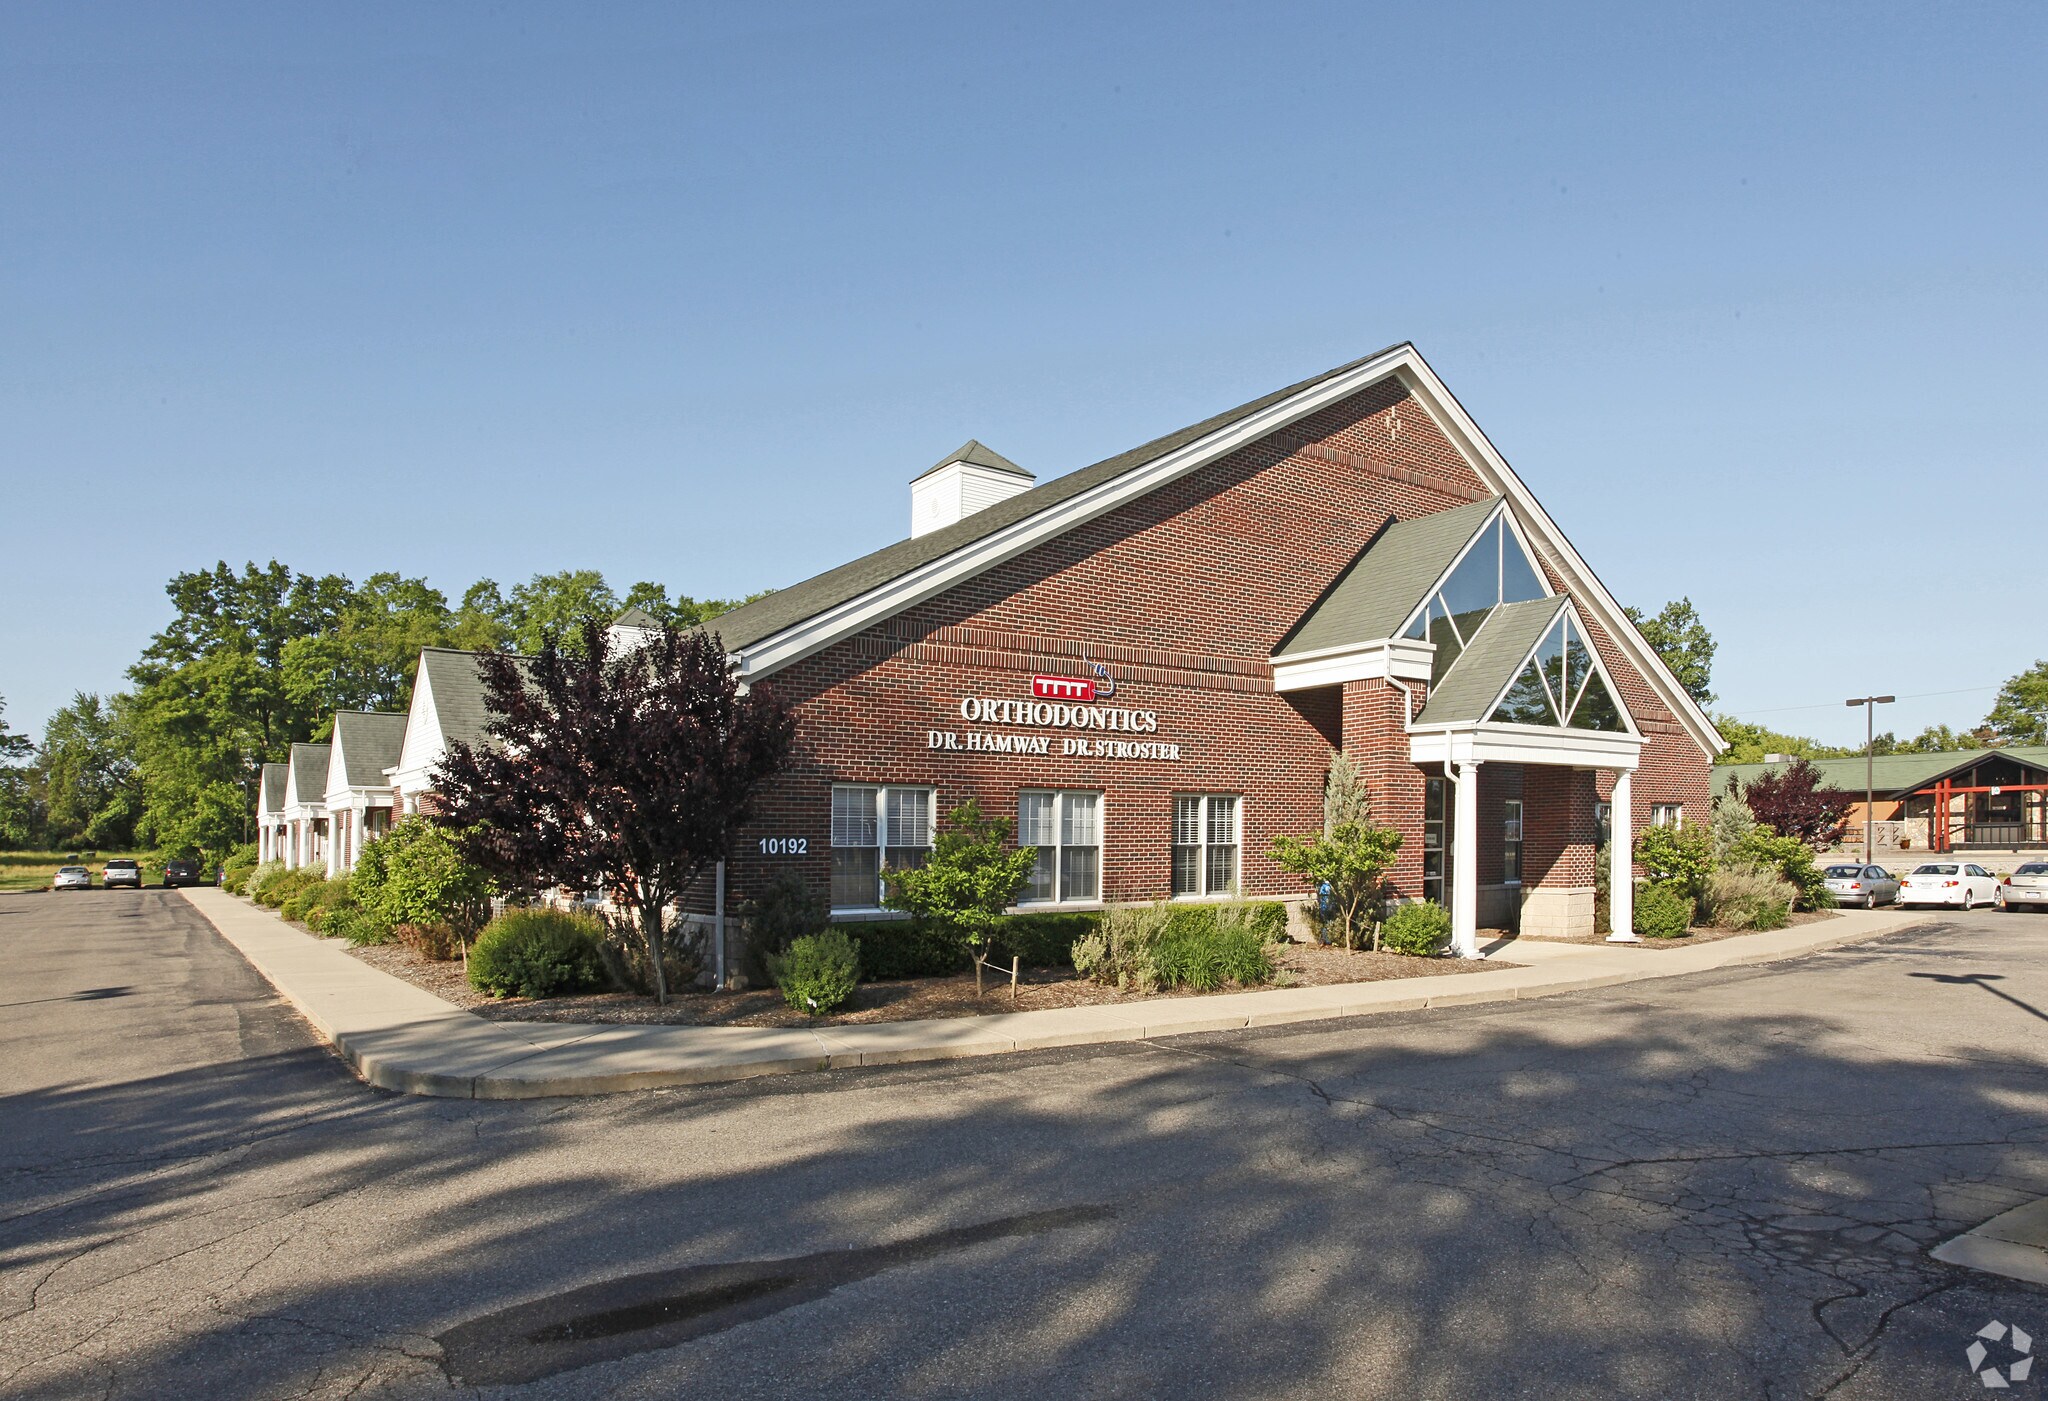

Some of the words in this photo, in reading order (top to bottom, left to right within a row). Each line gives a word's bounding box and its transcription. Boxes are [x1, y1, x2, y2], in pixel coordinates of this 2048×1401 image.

[960, 697, 1157, 733] ORTHODONTICS
[928, 730, 963, 749] DR.
[966, 732, 1051, 754] HAMWAY
[1063, 738, 1092, 756] DR.
[1095, 739, 1181, 760] STROSTER
[759, 838, 807, 854] 10192
